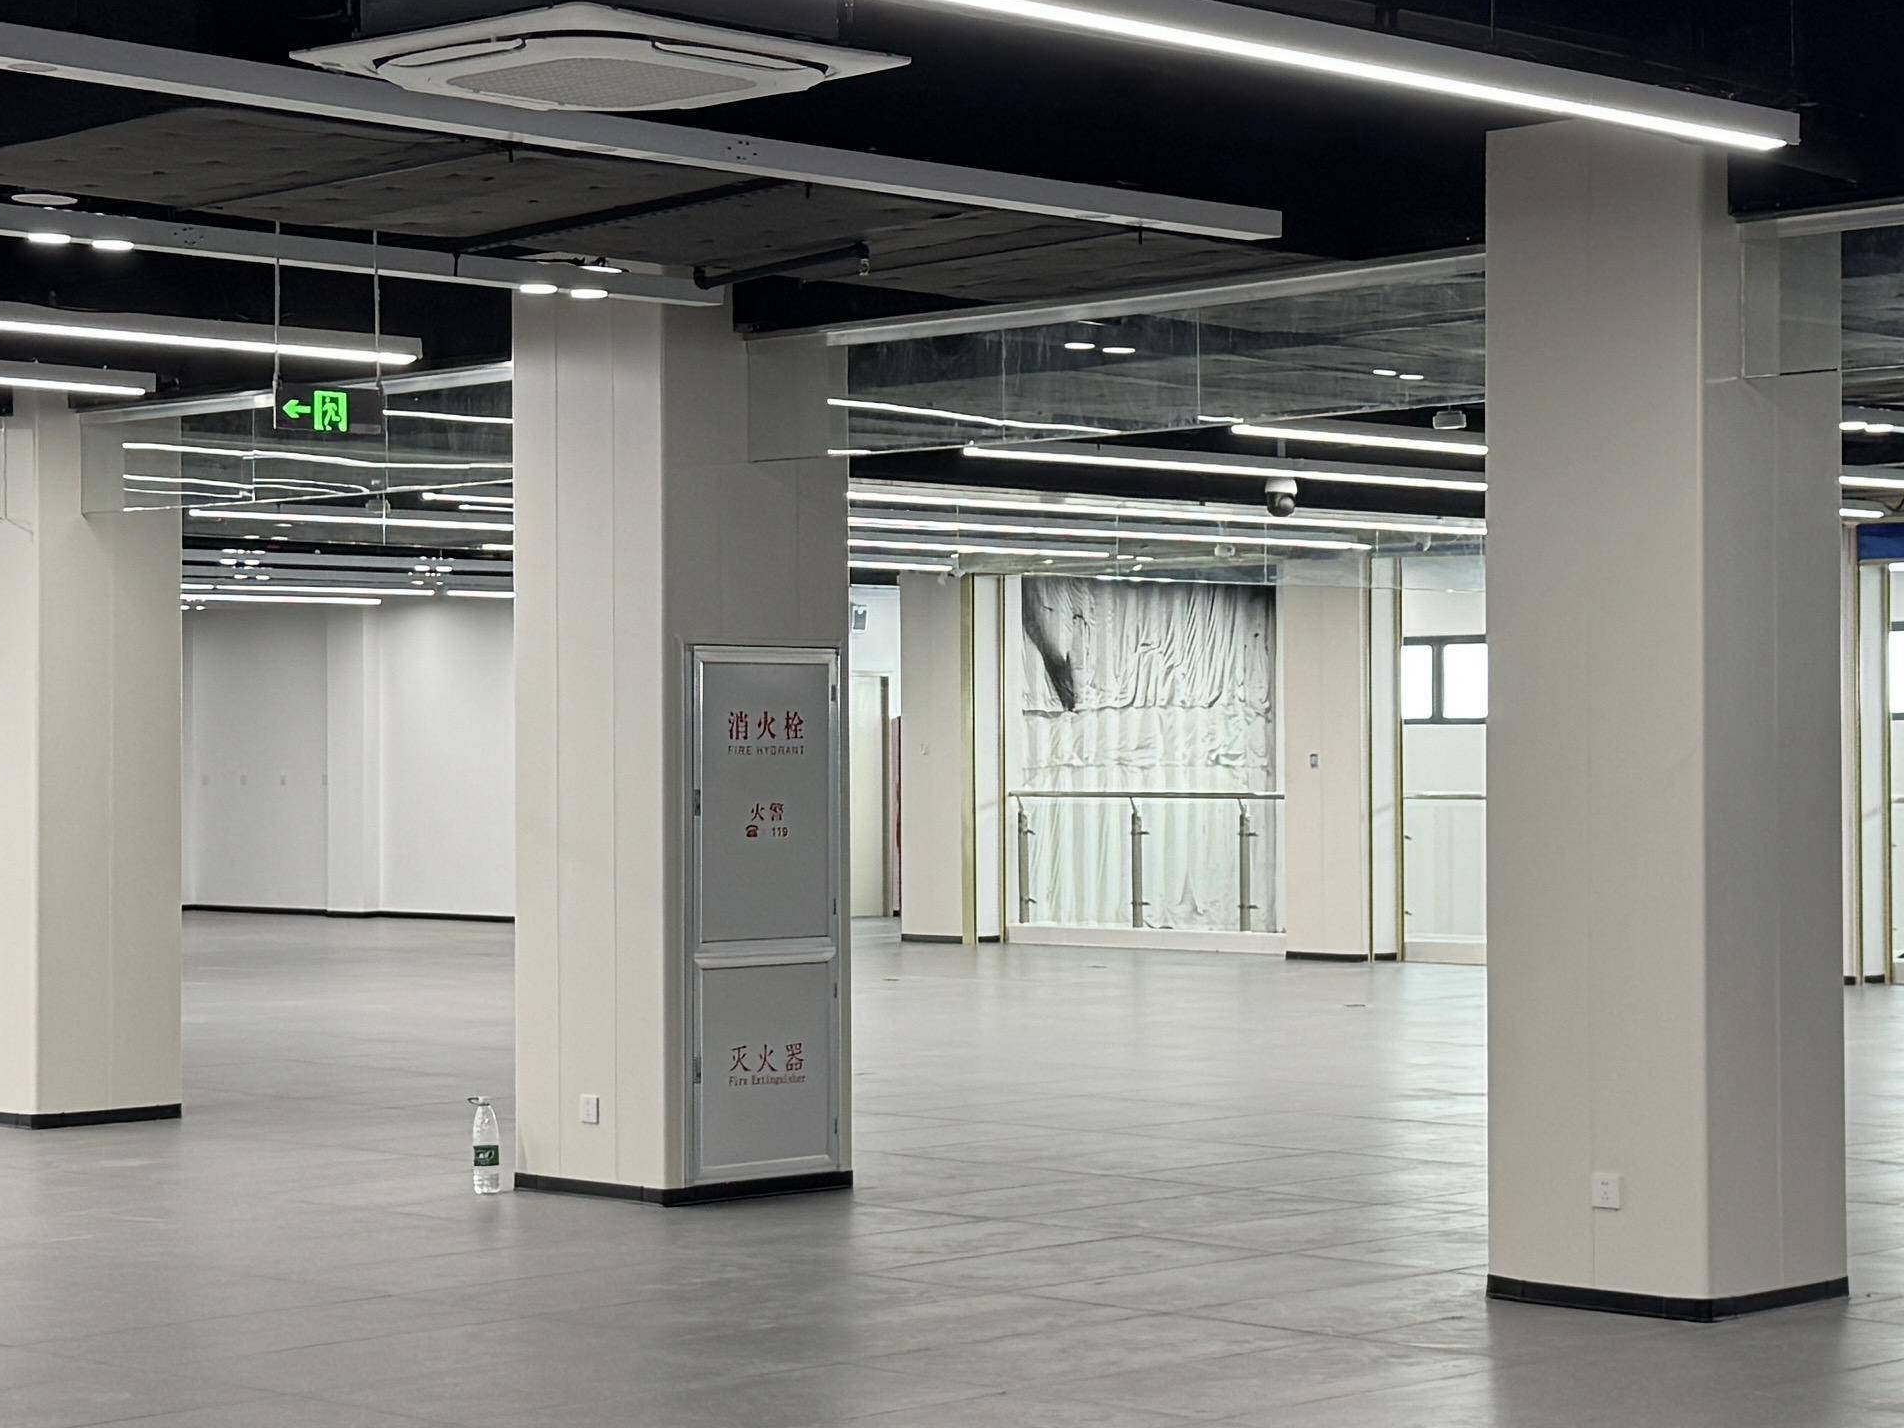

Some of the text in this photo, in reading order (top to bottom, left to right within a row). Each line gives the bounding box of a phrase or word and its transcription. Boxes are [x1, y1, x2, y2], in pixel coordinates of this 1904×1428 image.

[728, 711, 804, 740] 消火栓
[751, 803, 784, 821] 火警
[772, 827, 788, 837] 119
[729, 1042, 804, 1072] 灭火器
